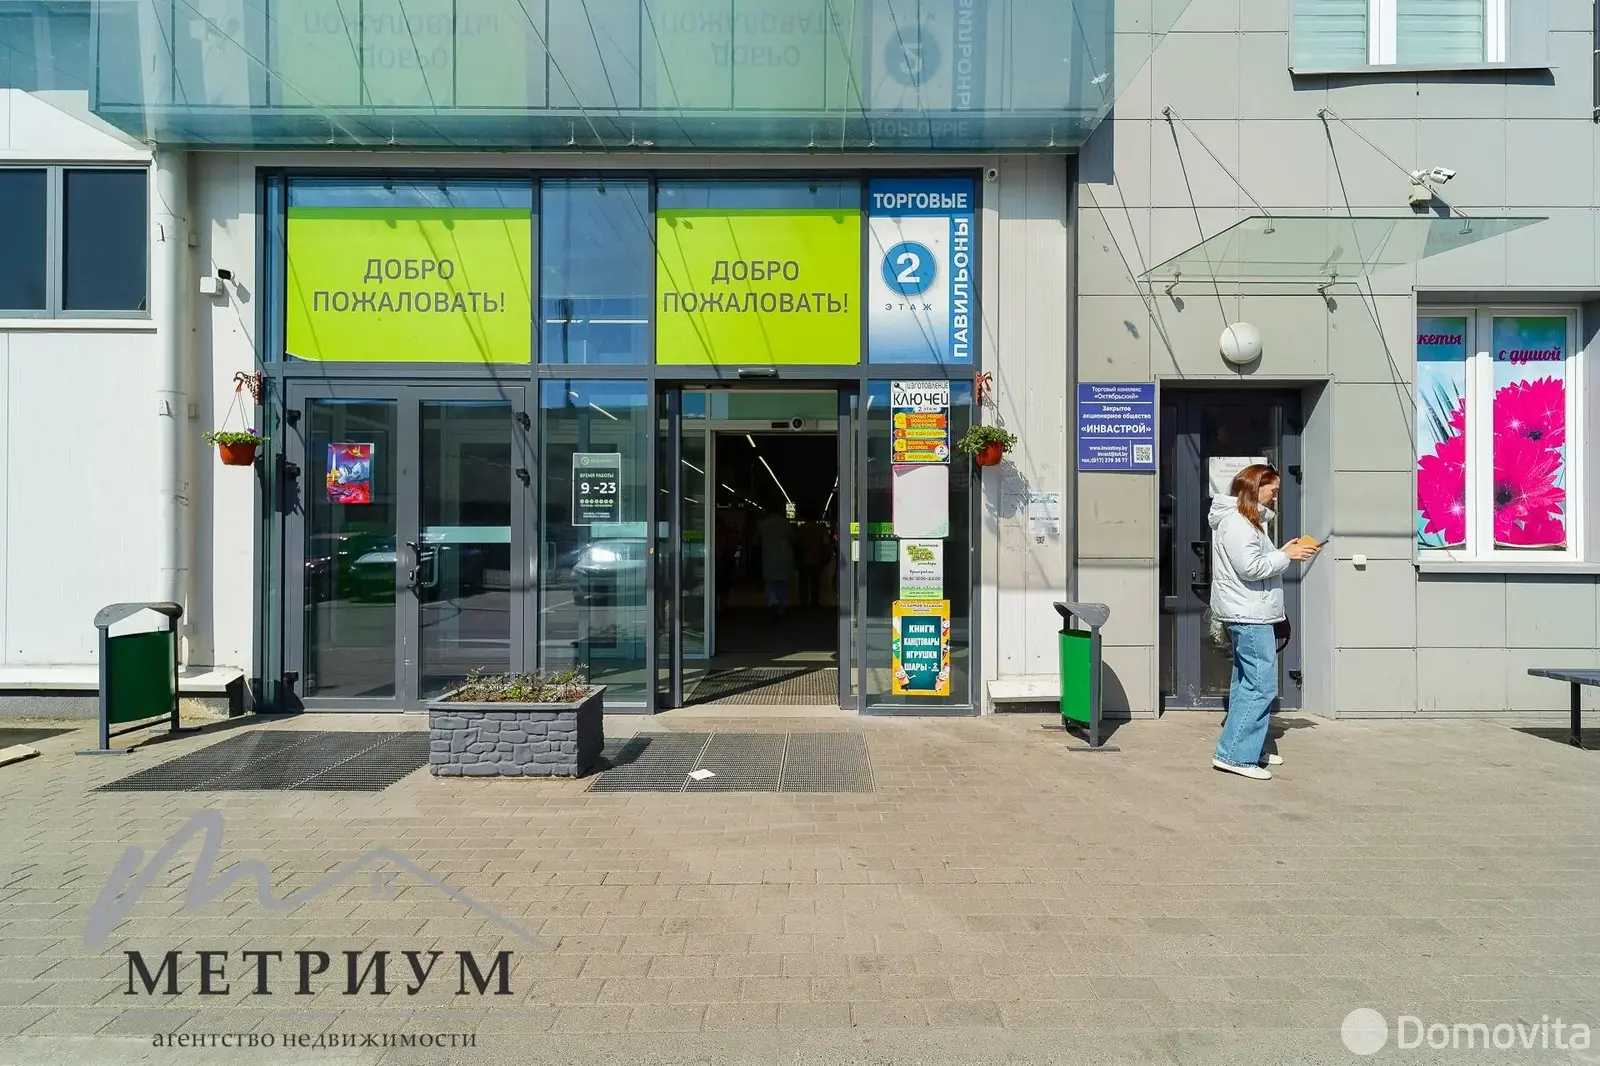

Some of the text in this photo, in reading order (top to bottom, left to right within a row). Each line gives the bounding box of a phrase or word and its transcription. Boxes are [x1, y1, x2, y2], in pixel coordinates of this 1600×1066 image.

[873, 192, 968, 210] ТОРГОВЫЕ
[363, 258, 456, 284] ДОБРО
[711, 260, 800, 285] ДОБРО
[896, 252, 921, 283] 2
[951, 216, 969, 359] ПАВИЛЬОНЫ
[312, 290, 506, 313] ПОЖАЛОВАТЬ!
[663, 291, 849, 313] ПОЖАЛОВАТЬ!
[884, 302, 935, 312] ЭТАЖ
[1417, 332, 1463, 346] кеты
[1509, 346, 1561, 365] душой
[893, 391, 949, 406] КЛЮЧЕЙ
[1081, 422, 1152, 434] «ИНВАСТРОЙ»
[580, 482, 590, 494] 9
[908, 624, 936, 634] КНИГИ
[904, 637, 940, 648] КАНЦТОВАРЫ
[906, 650, 938, 659] ИГРУШКИ
[904, 663, 928, 672] ШАРЫ
